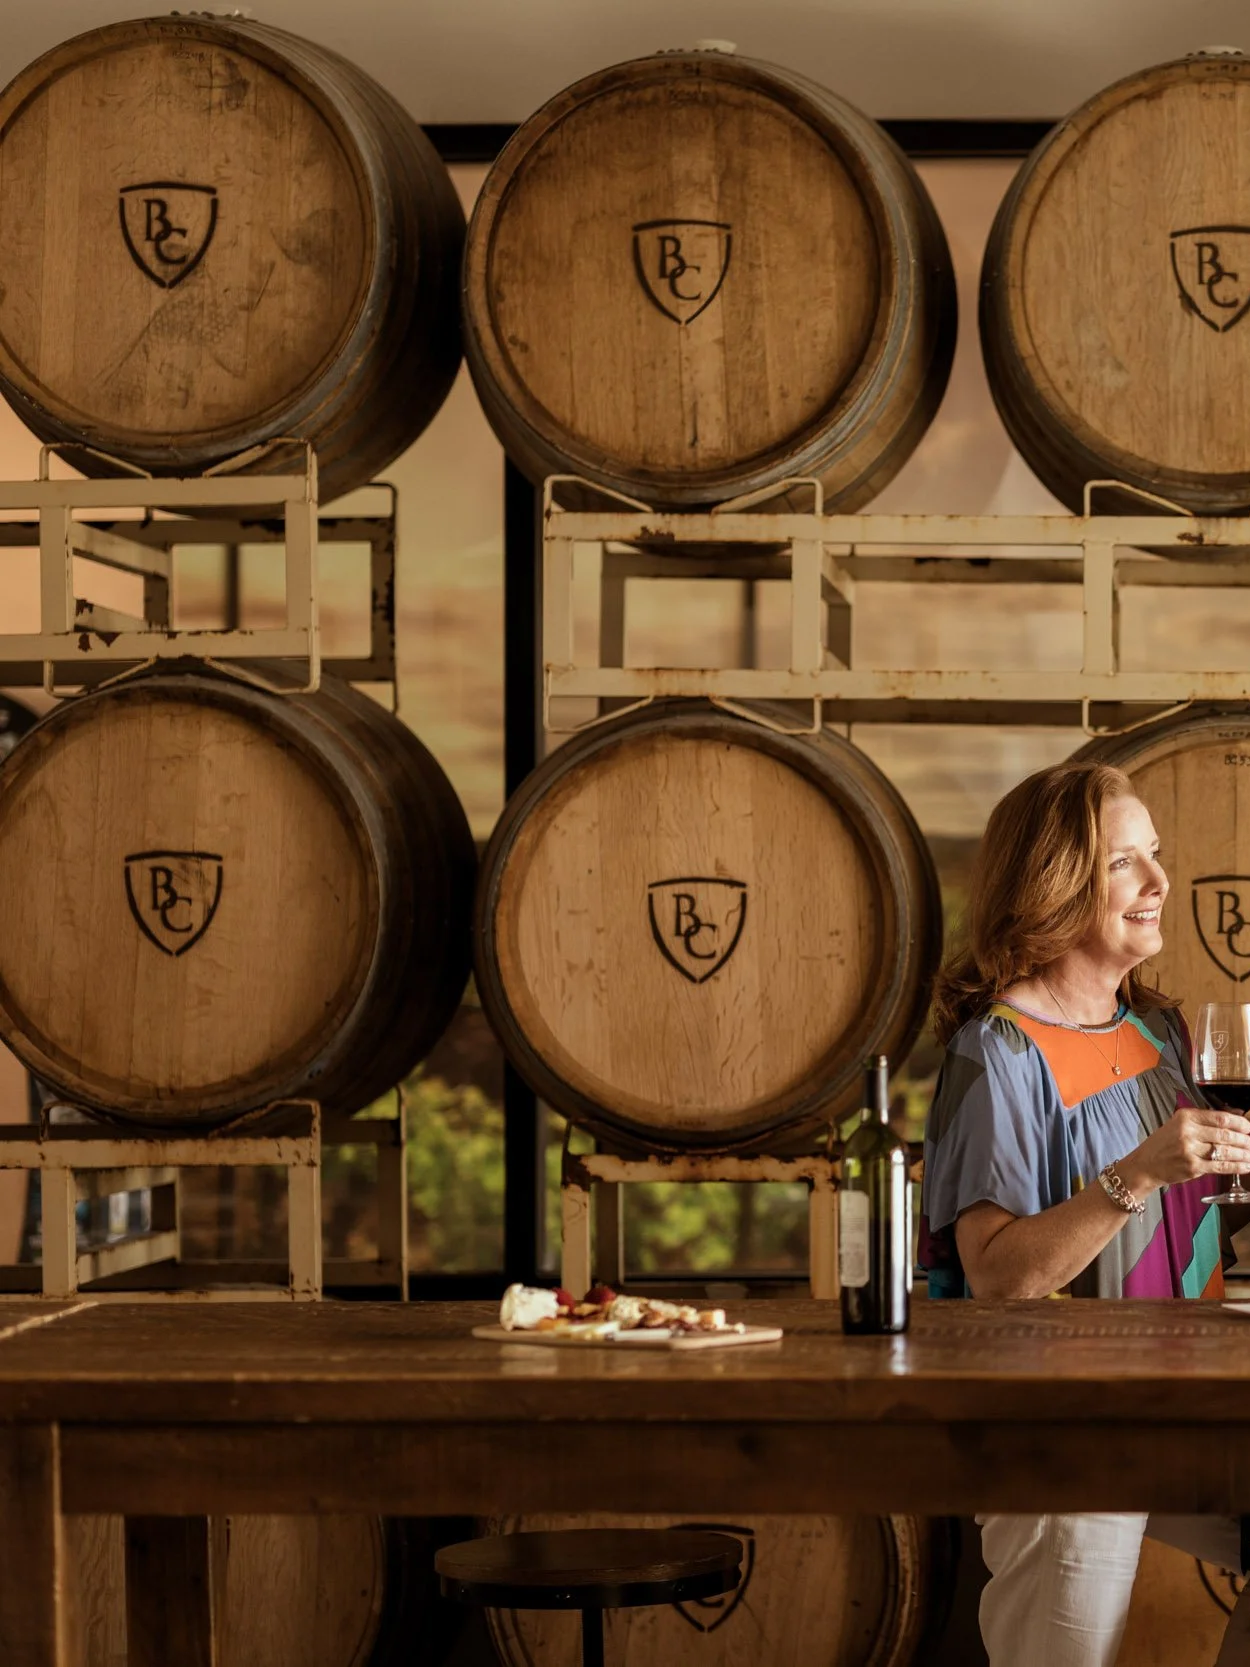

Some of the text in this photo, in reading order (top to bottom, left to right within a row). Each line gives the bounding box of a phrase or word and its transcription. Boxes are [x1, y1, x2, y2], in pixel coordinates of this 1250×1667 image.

[144, 196, 189, 262] BC
[657, 235, 700, 300] BC
[1195, 242, 1239, 308] BC
[150, 866, 192, 932] BC
[673, 894, 717, 959] BC
